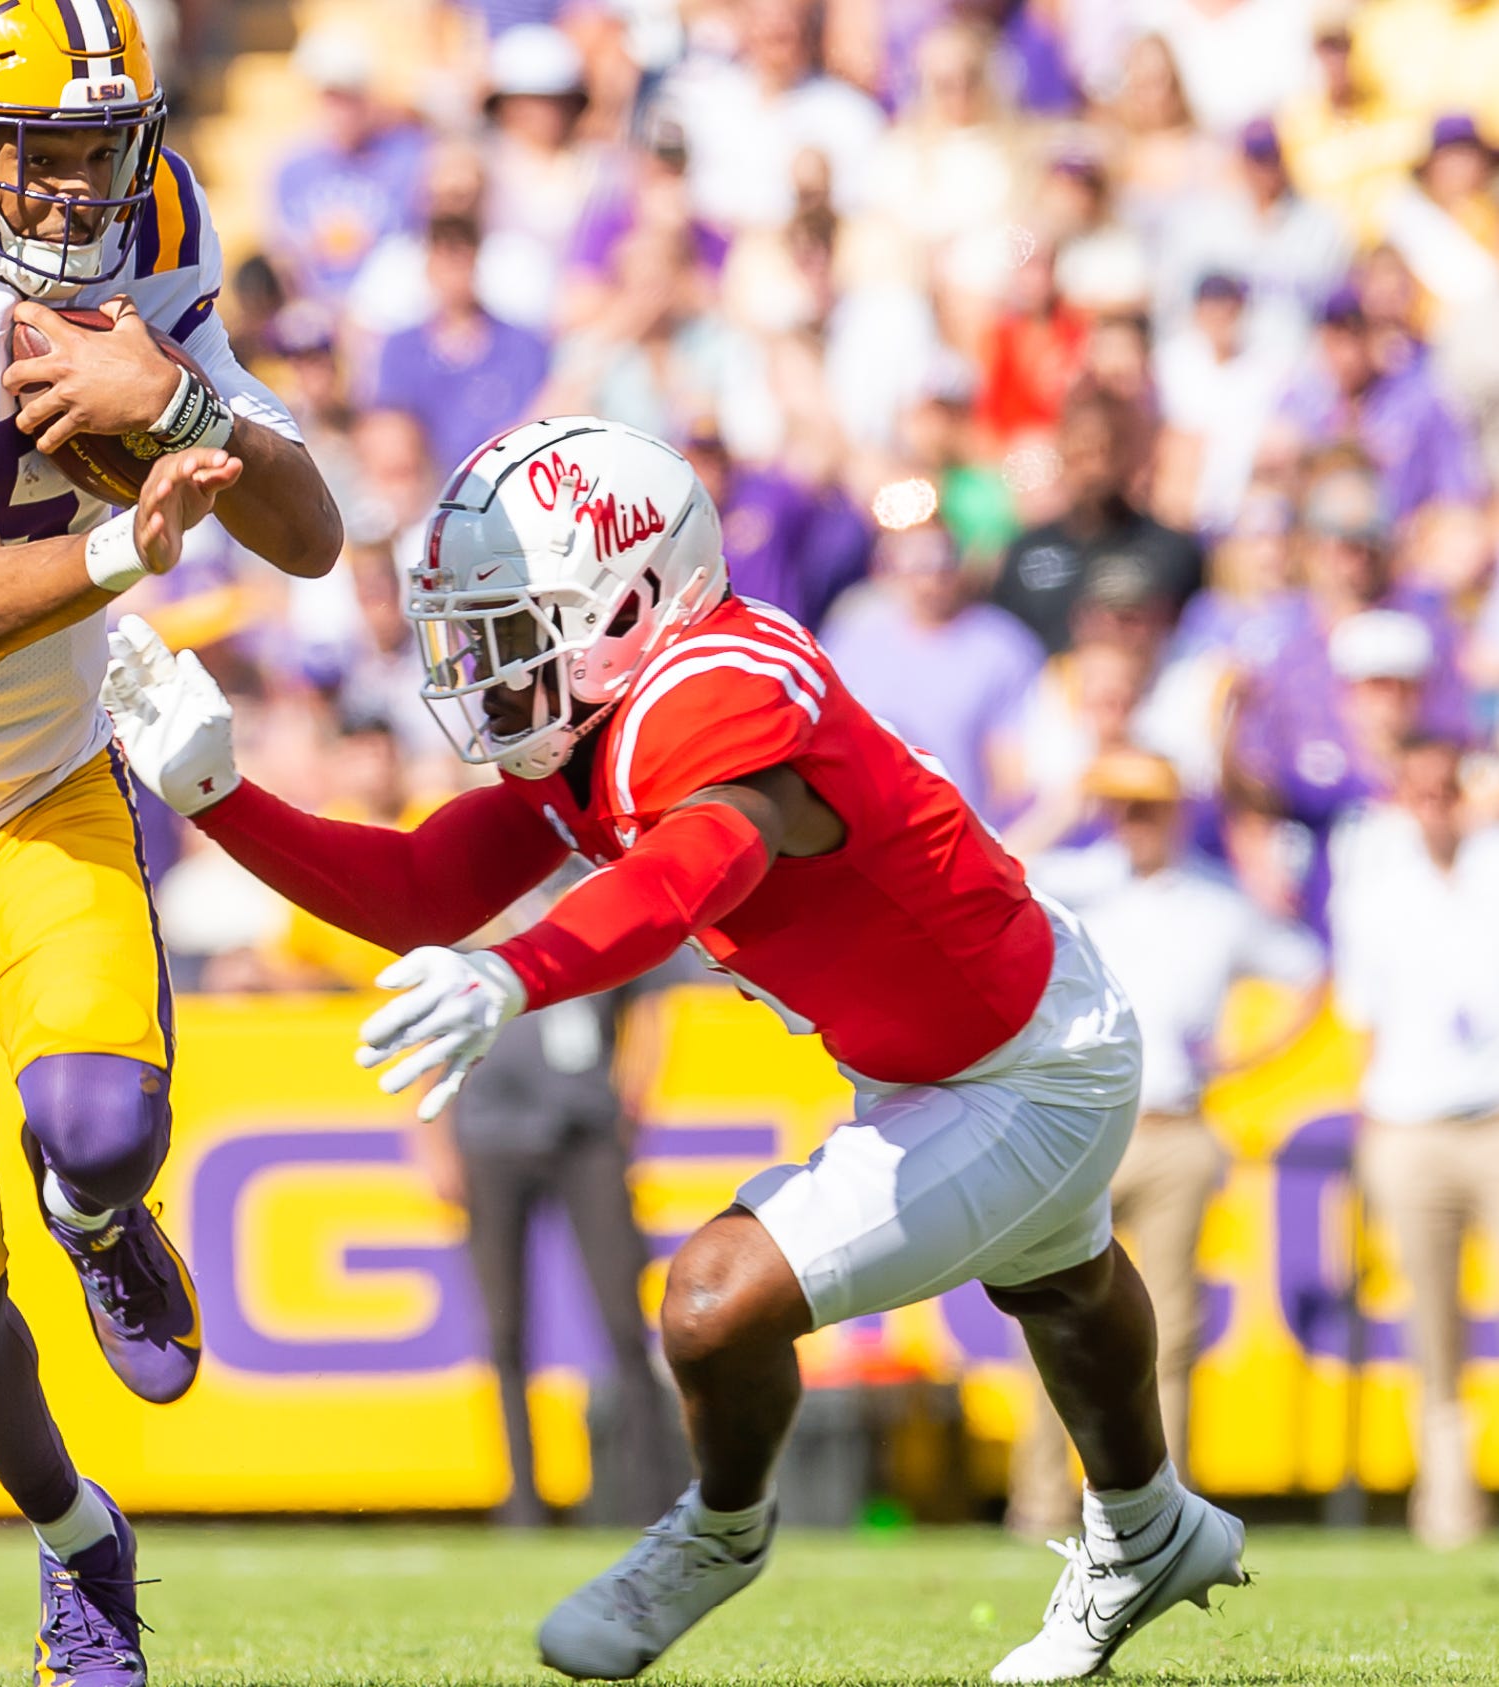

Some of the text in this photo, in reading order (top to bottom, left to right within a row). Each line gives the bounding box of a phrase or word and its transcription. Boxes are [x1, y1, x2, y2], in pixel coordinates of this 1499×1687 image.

[86, 83, 126, 103] LSU
[169, 392, 199, 436] Excuses
[191, 399, 215, 440] History
[528, 451, 589, 511] Ole
[575, 492, 666, 562] Miss
